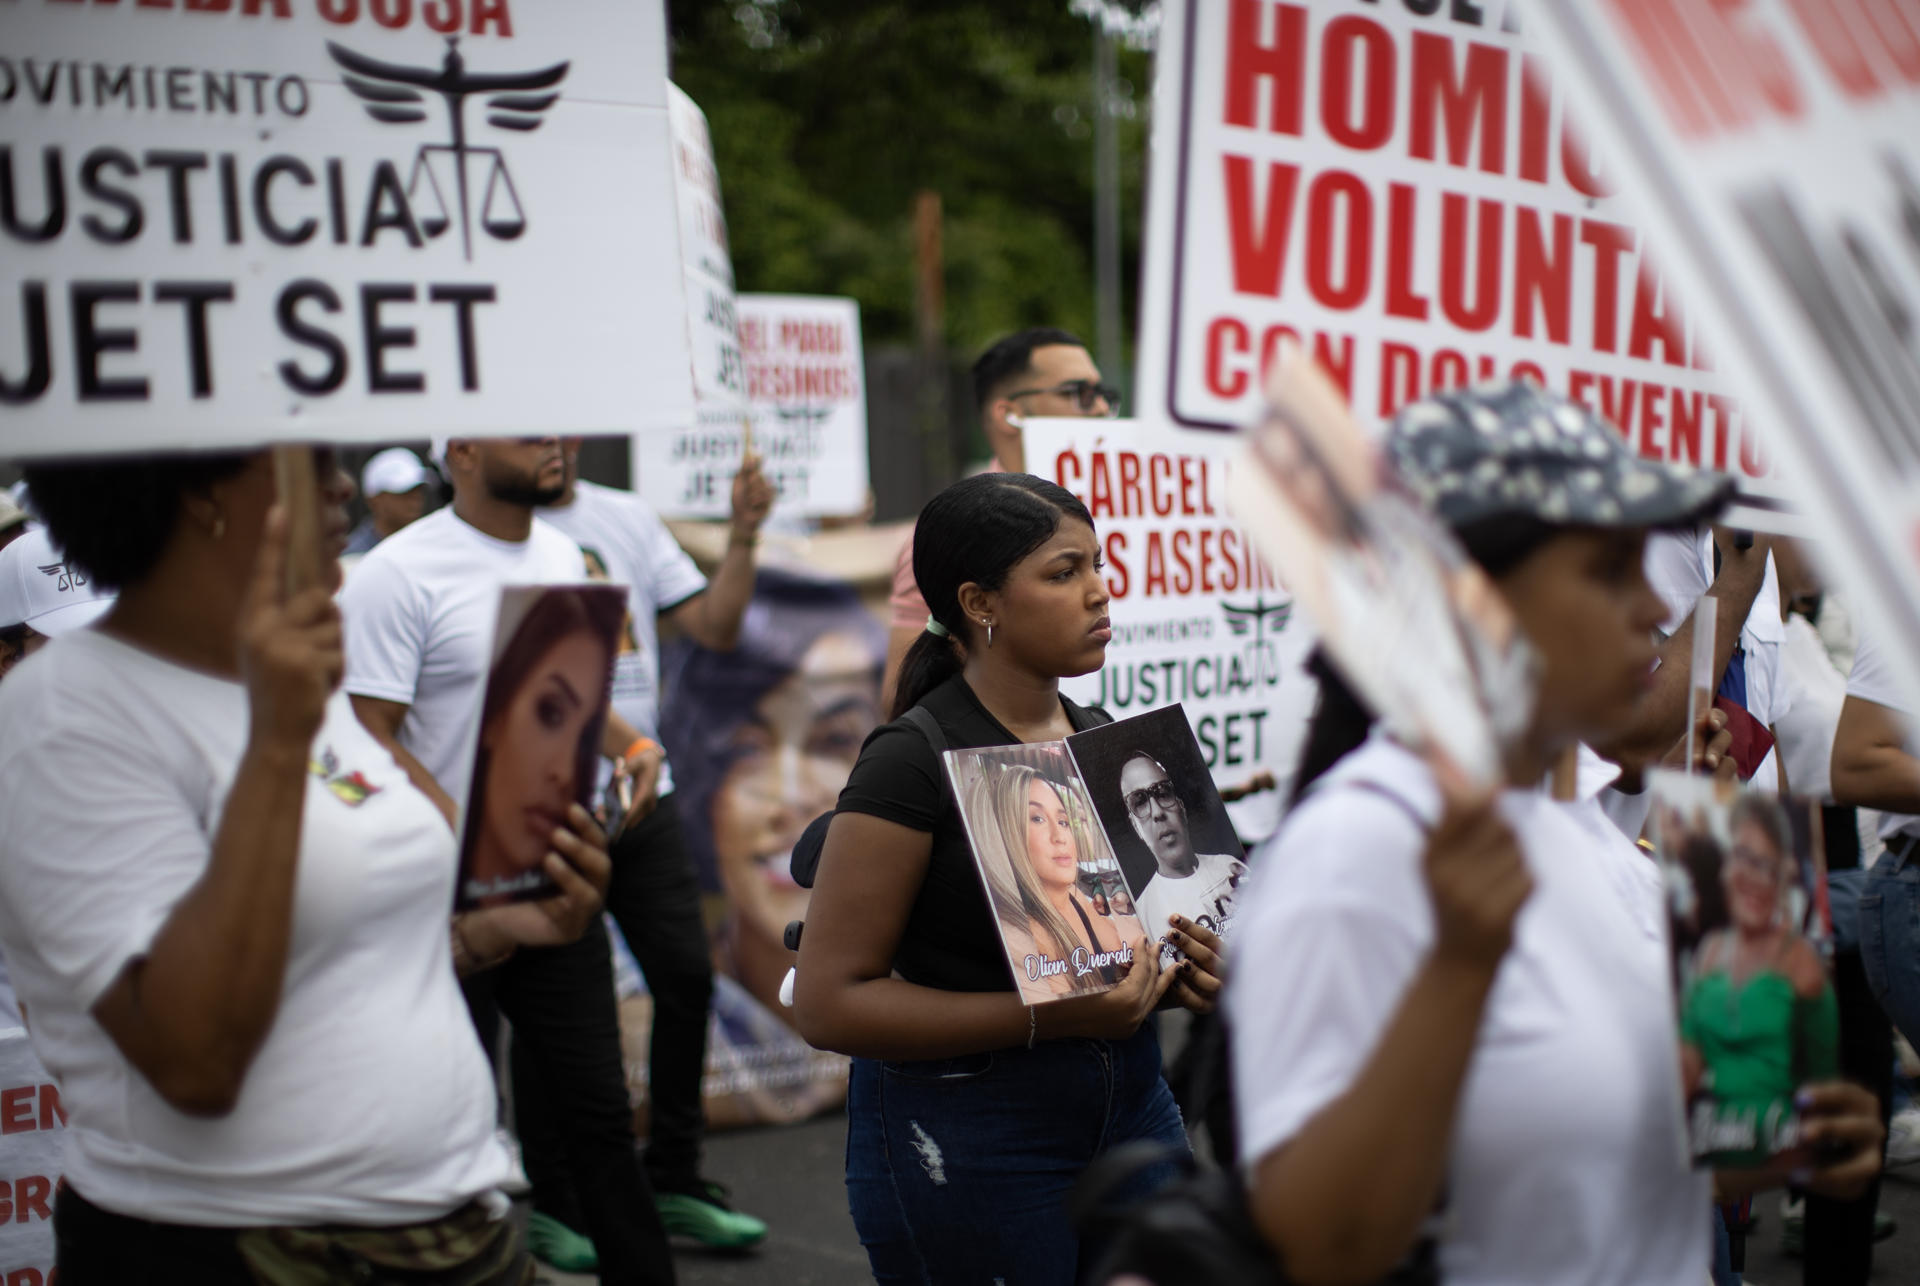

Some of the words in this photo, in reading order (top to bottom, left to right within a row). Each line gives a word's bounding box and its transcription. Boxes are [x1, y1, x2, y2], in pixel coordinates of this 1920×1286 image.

[0, 57, 310, 117] OVIMIENTO
[0, 143, 425, 249] USTICIA
[1221, 152, 1712, 374] VOLUNTA
[0, 280, 236, 404] JET
[276, 278, 498, 397] SET
[1111, 615, 1214, 648] OVIMIENTO
[1090, 654, 1250, 709] JUSTICIA
[1199, 709, 1269, 769] SET
[1024, 954, 1068, 982] Olian
[1071, 941, 1134, 977] Querale
